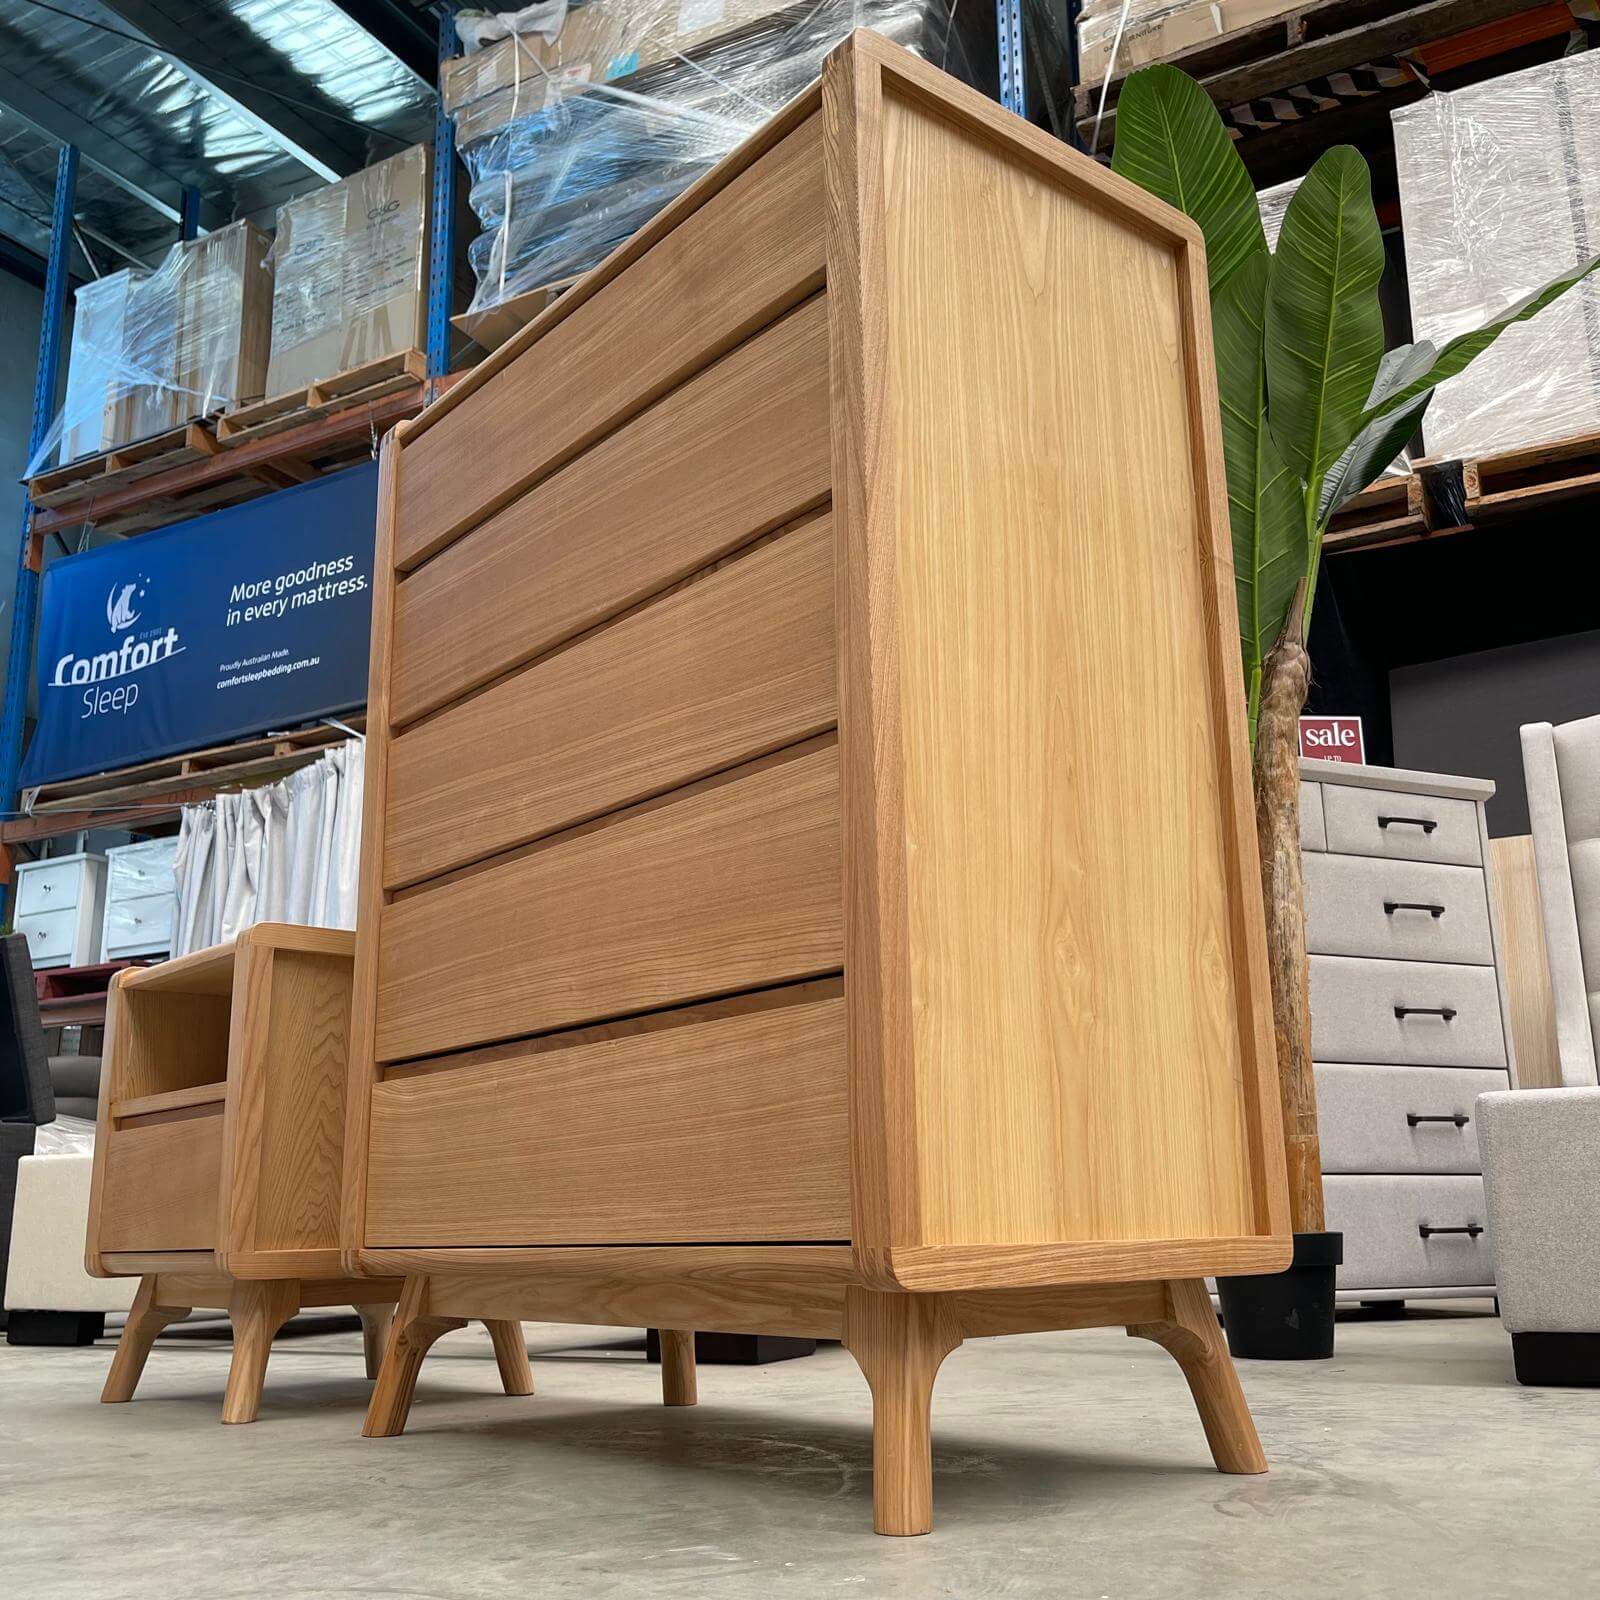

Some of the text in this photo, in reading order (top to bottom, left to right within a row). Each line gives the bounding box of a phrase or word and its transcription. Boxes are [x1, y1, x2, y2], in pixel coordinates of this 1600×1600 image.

[229, 555, 354, 603] More goodness
[226, 575, 368, 626] in every mattress.
[54, 627, 179, 686] Comfort
[216, 656, 320, 689] comfortsleepbedding.com.au
[219, 661, 241, 672] Proudly
[242, 653, 270, 666] Australian
[81, 683, 139, 719] Sleep
[1305, 721, 1356, 747] sale
